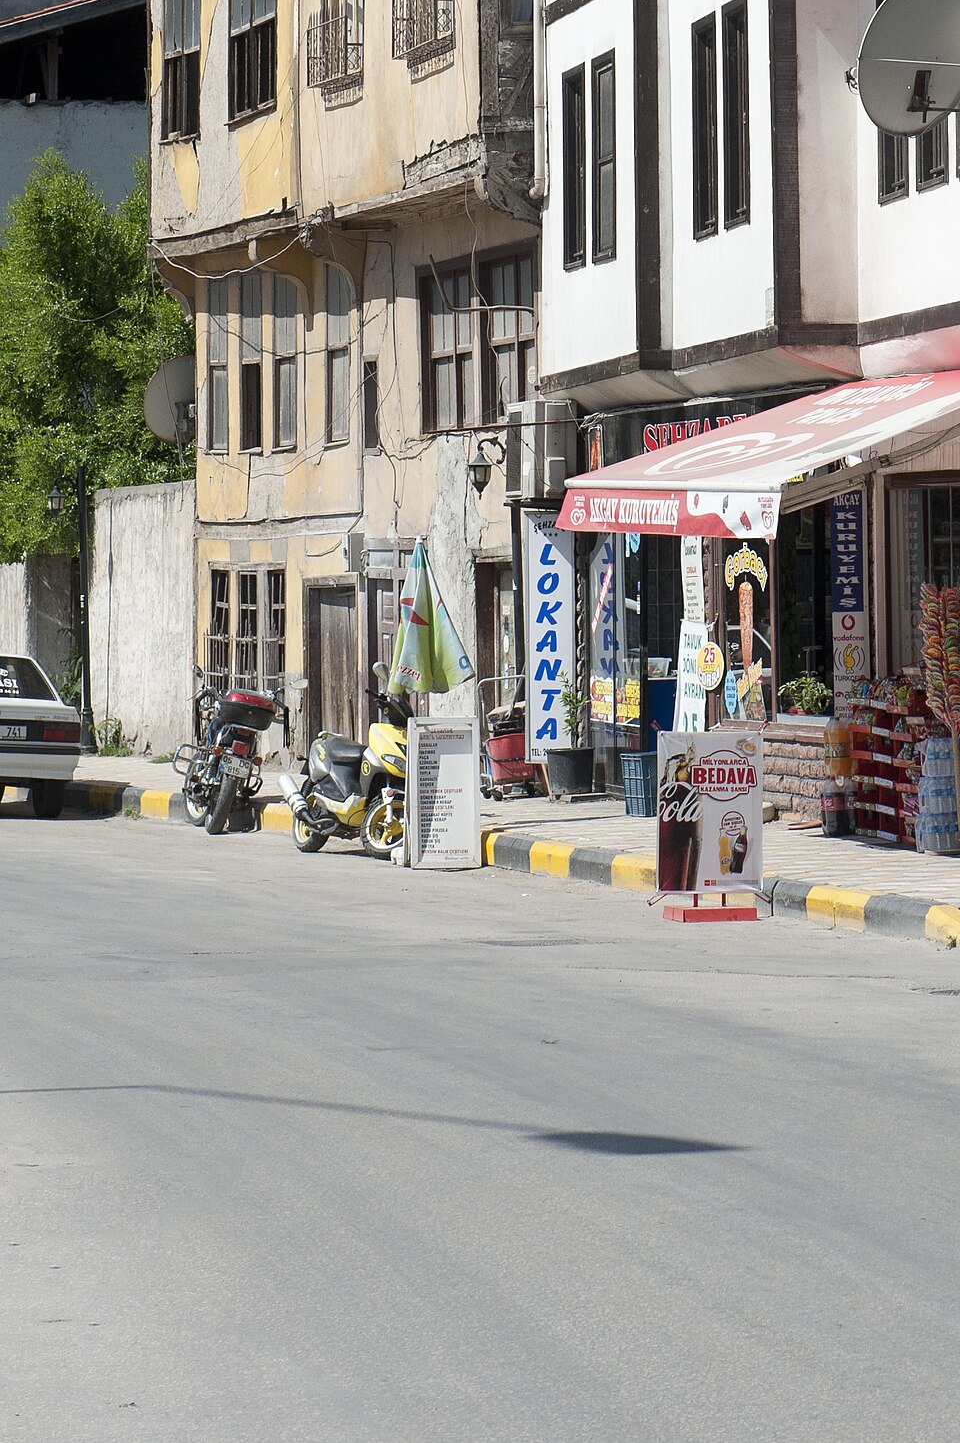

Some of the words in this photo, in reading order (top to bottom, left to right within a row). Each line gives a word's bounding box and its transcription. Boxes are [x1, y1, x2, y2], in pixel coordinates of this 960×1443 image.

[833, 493, 860, 509] AKÇAY
[589, 497, 618, 529] AKÇAY
[618, 493, 680, 533] KURUYEMİŞ
[835, 511, 860, 608] KURUYEMİŞ
[534, 543, 563, 740] LOKANTA
[684, 633, 703, 650] TAVUK
[704, 647, 715, 663] 25
[7, 726, 21, 738] 741
[223, 755, 233, 765] 05
[702, 757, 747, 766] MİLYONLARCA
[693, 767, 756, 785] BEDAVA
[730, 786, 748, 794] ŞANSI
